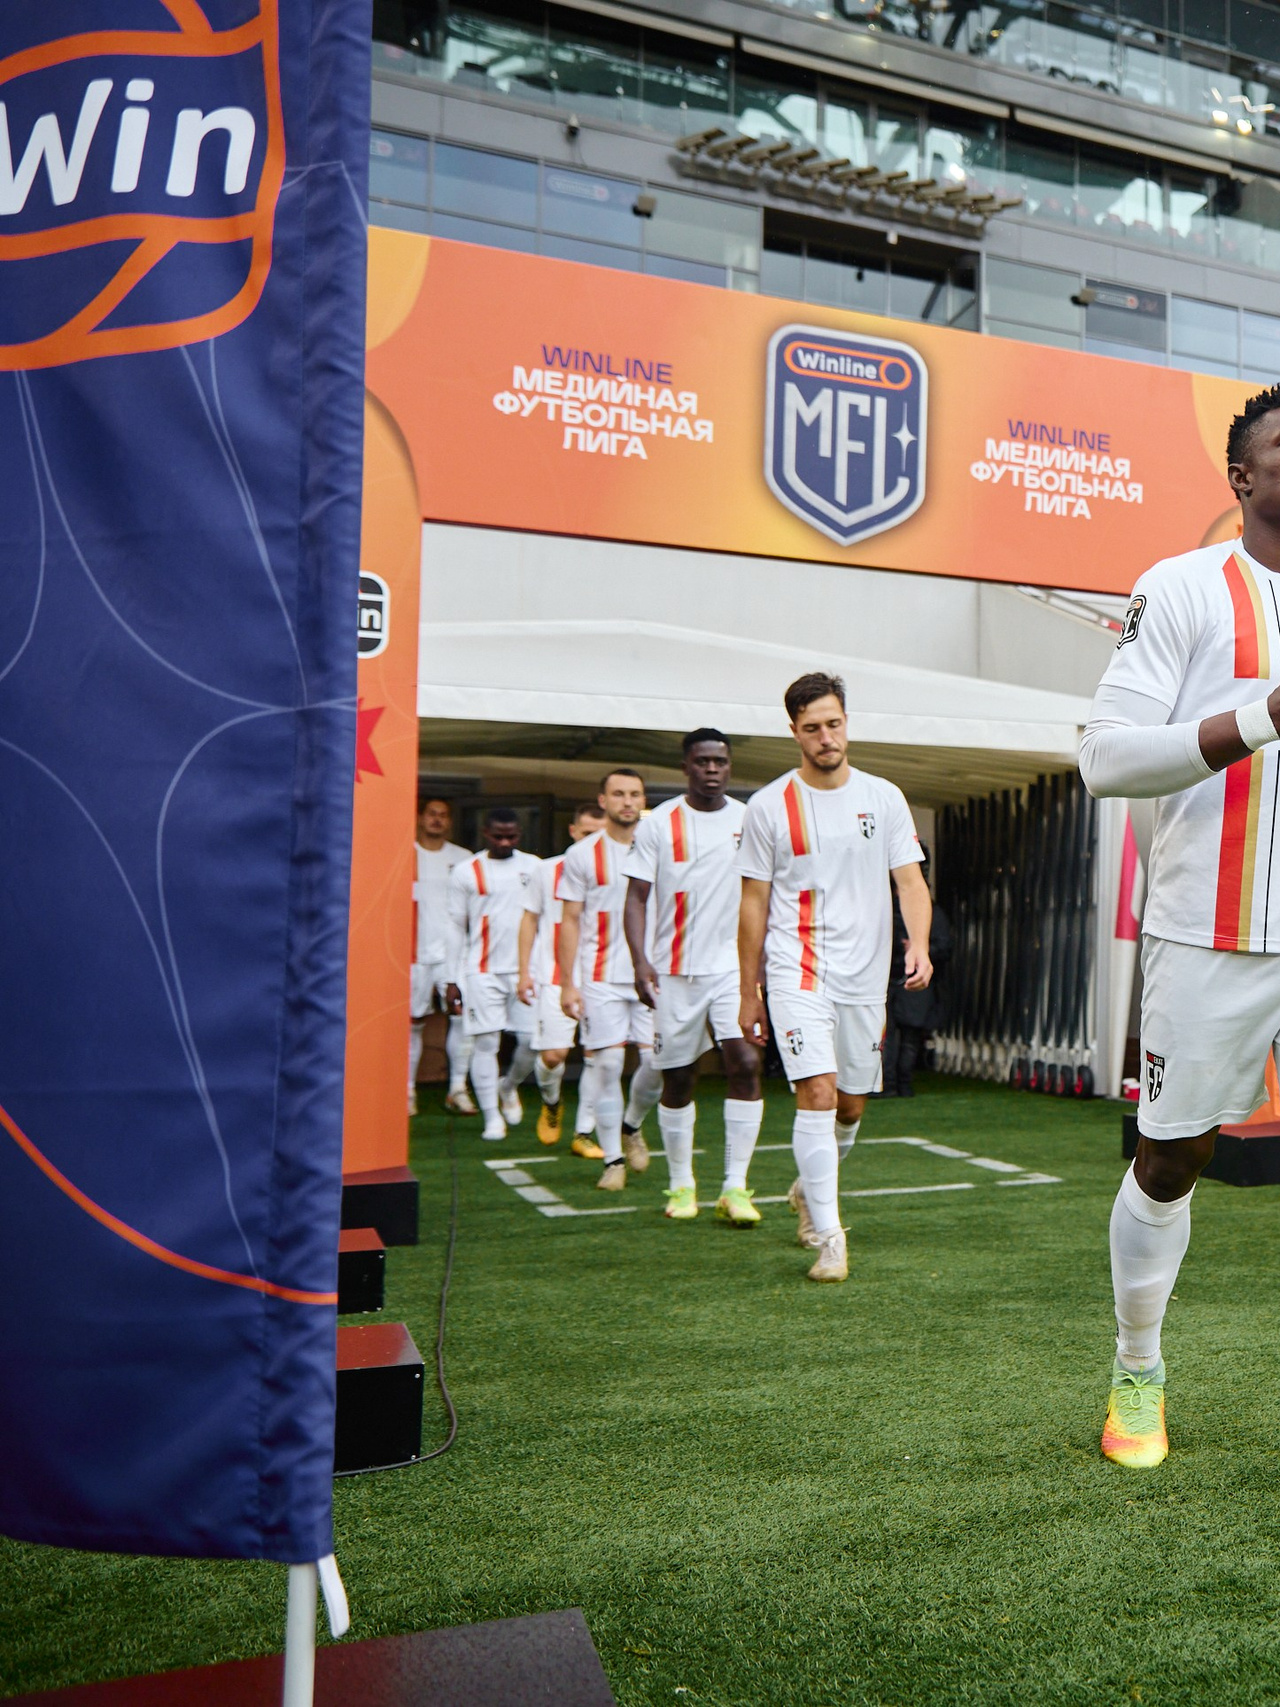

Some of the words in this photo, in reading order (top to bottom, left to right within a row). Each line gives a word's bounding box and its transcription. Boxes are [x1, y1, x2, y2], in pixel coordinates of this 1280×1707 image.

[0, 78, 256, 215] Win
[542, 344, 673, 384] WINLINE
[797, 348, 878, 380] Winline
[513, 365, 698, 415] МЕДИЙНАЯ
[492, 391, 714, 443] ФУТБОЛЬНАЯ
[1008, 419, 1111, 453] WINLINE
[563, 426, 648, 460] ЛИГА
[782, 381, 910, 528] MFL
[985, 438, 1131, 479] МЕДИЙНАЯ
[970, 460, 1144, 504] ФУТБОЛЬНАЯ
[1024, 490, 1092, 520] ЛИГА
